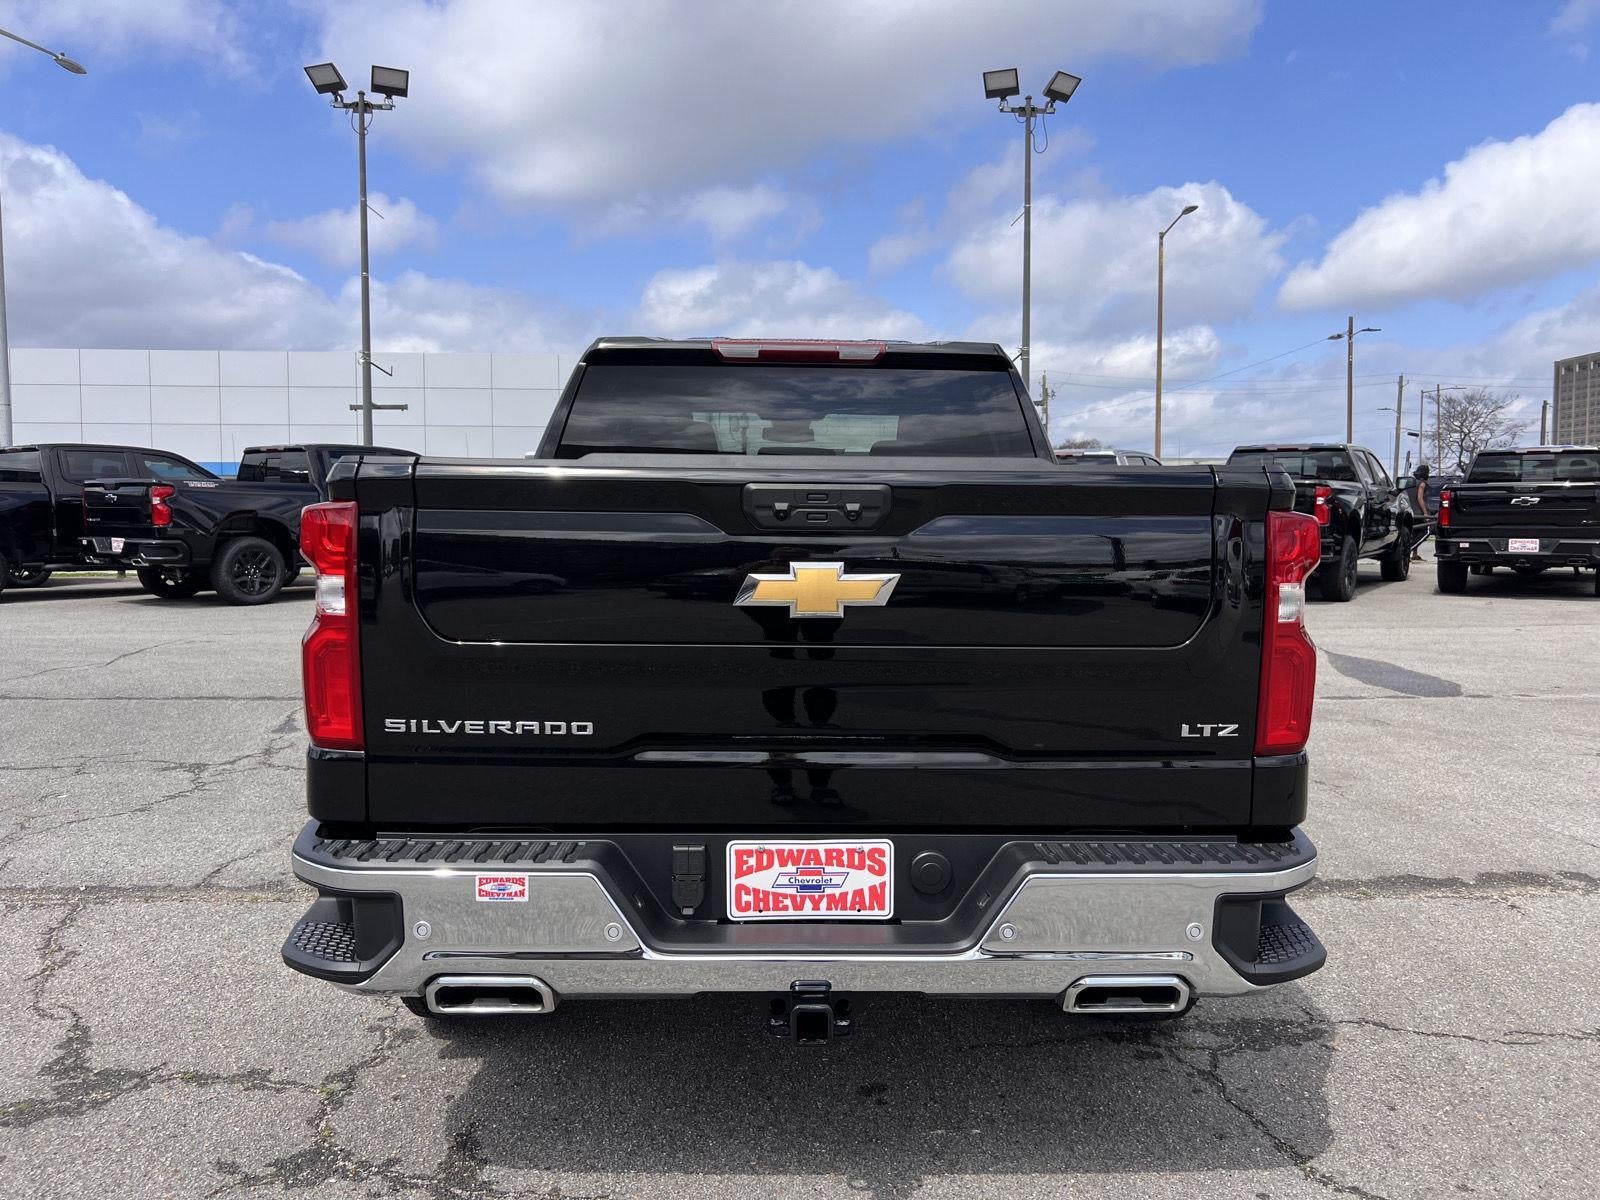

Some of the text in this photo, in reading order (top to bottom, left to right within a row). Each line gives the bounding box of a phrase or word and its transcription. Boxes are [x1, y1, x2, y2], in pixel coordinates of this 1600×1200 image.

[384, 718, 594, 736] SILVERADO
[1180, 723, 1239, 737] LTZ
[734, 847, 887, 879] EDWARDS
[478, 877, 526, 888] EDWARDS
[788, 876, 833, 884] Chevrolet
[478, 888, 526, 897] CHEVYMAN
[734, 881, 887, 913] CHEVYMAN
